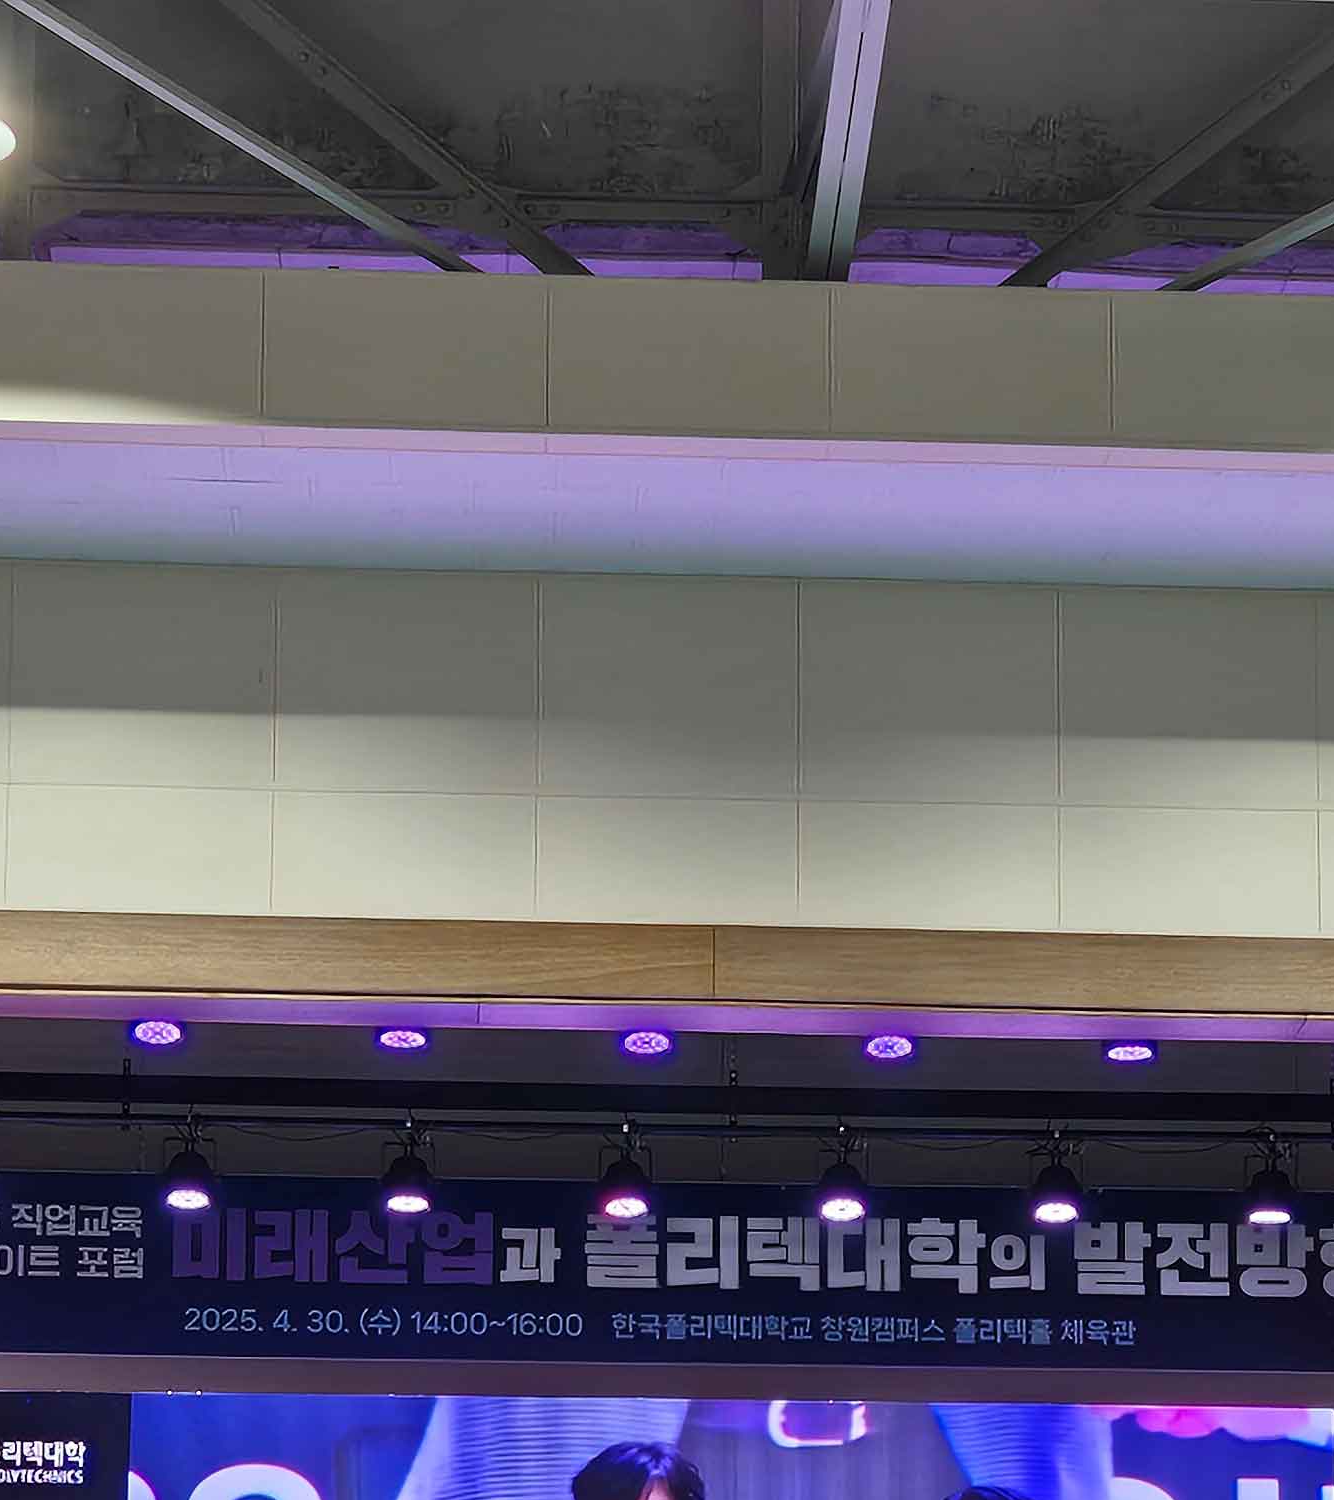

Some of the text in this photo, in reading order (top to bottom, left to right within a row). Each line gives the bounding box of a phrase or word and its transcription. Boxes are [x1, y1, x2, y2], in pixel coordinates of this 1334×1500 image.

[11, 1203, 144, 1239] 직업교육
[76, 1247, 145, 1279] 포럼
[170, 1207, 562, 1286] 미래산업과
[584, 1213, 1046, 1296] 폴리텍대학의
[183, 1308, 265, 1332] 2025.
[272, 1309, 299, 1333] 4.
[307, 1310, 351, 1334] 30.
[359, 1307, 402, 1336] (수)
[411, 1311, 584, 1337] 14:00~16:00
[611, 1312, 813, 1342] 한국폴리텍대학교
[820, 1314, 946, 1344] 창원캠퍼스
[1060, 1317, 1138, 1346] 체육관
